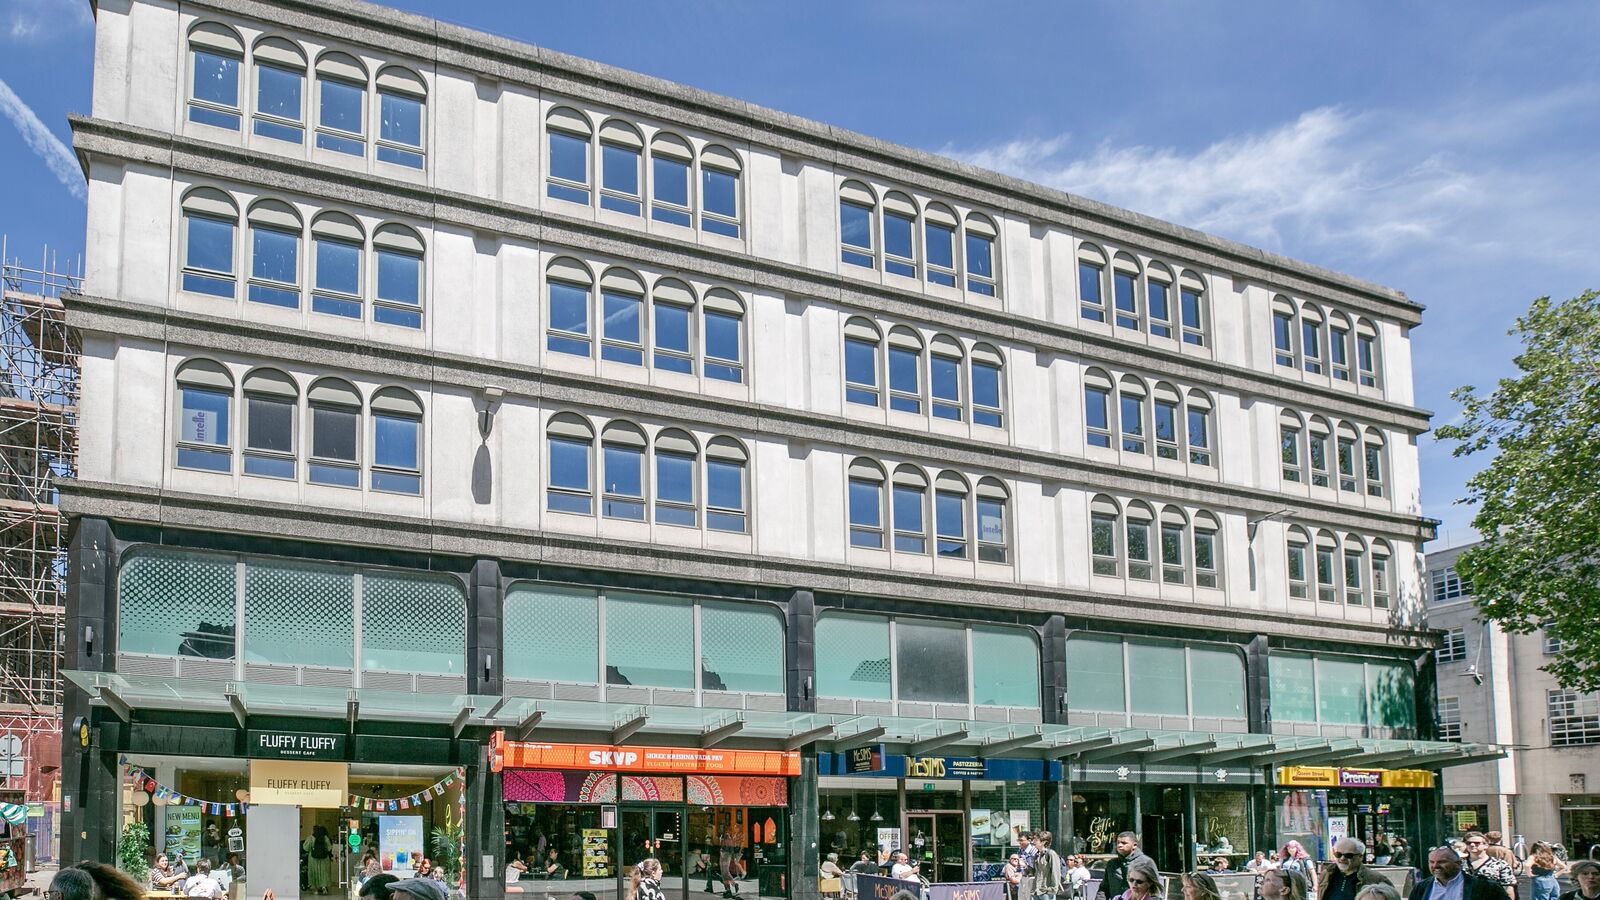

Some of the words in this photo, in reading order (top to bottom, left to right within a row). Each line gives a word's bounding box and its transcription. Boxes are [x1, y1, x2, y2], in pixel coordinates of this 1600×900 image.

[260, 734, 297, 748] FLUFFY
[300, 736, 336, 750] FLUFFY
[589, 751, 637, 765] SKVP
[853, 747, 872, 762] McSIMS
[906, 756, 946, 777] McSIMS
[1342, 772, 1379, 783] Premier
[267, 779, 298, 789] FLUFFY
[301, 780, 331, 790] FLUFFY
[182, 812, 200, 820] MENU
[880, 833, 899, 841] OFFER
